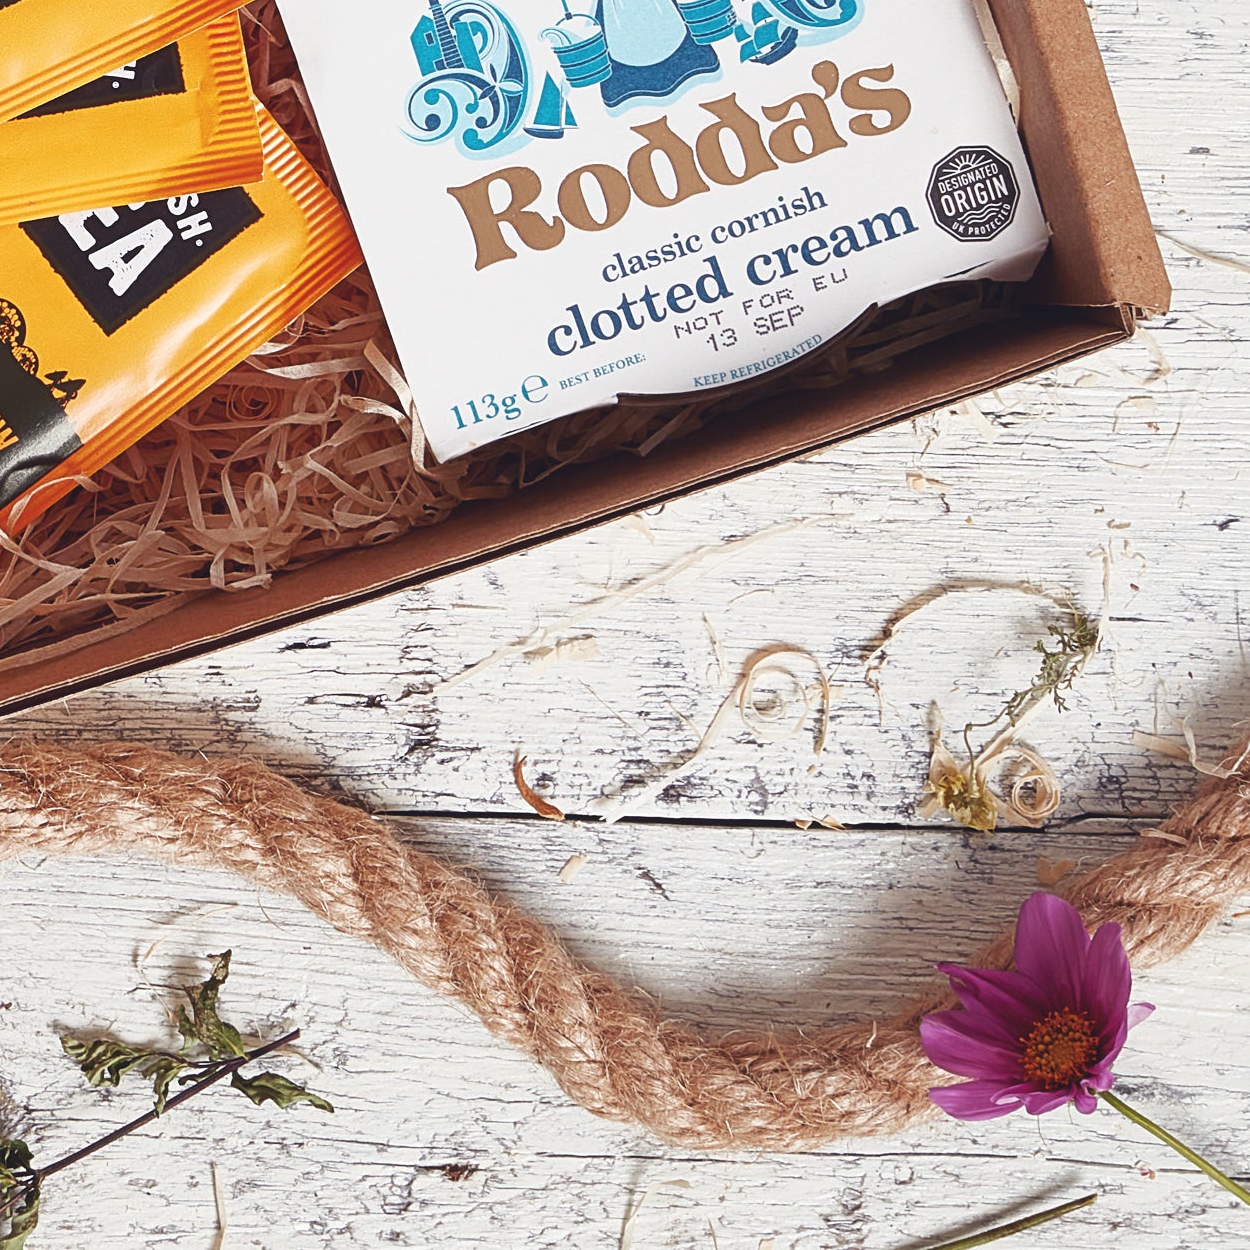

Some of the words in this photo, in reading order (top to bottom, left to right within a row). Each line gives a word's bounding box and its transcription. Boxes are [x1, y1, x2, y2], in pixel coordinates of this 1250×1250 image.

[446, 59, 912, 271] Rodda's
[937, 163, 999, 194] DESIGNATED
[940, 174, 1009, 217] ORIGIN
[951, 221, 965, 233] UK
[967, 203, 1011, 235] PROTECTED
[58, 202, 173, 297] EA
[601, 231, 703, 283] classic
[710, 186, 828, 245] cornish
[546, 256, 734, 356] clotted
[745, 203, 919, 286] cream
[673, 309, 724, 340] NOT
[742, 287, 794, 316] FOR
[813, 269, 849, 291] EU
[707, 327, 738, 352] 13
[753, 305, 805, 337] SEP
[559, 370, 591, 391] BEST
[593, 353, 647, 378] BEFORE:
[693, 371, 728, 388] KEEP
[729, 333, 823, 379] REFRIGERATED
